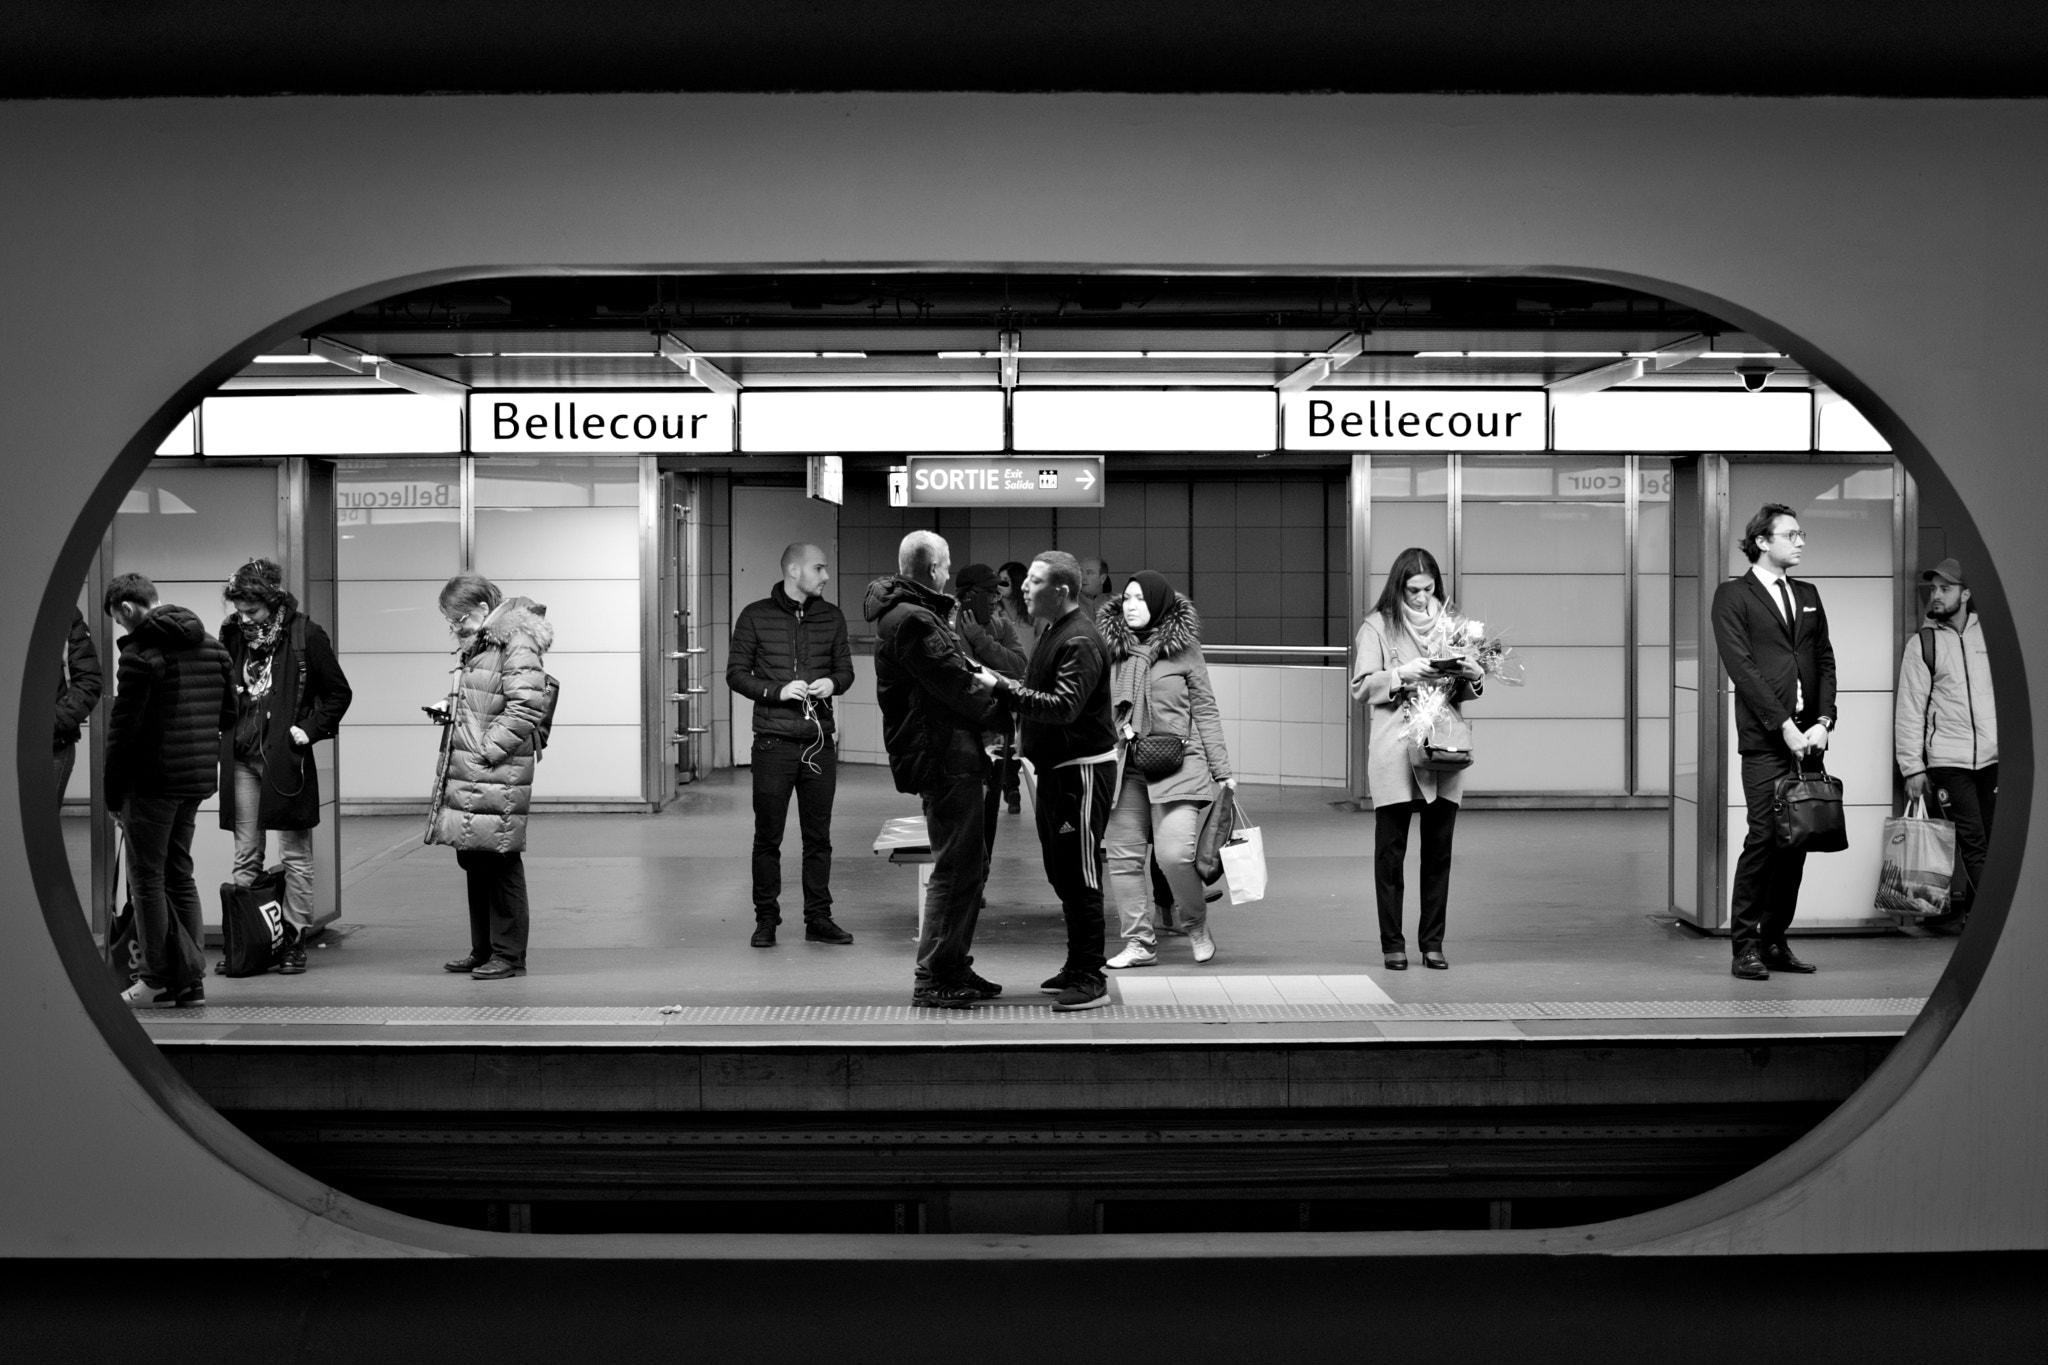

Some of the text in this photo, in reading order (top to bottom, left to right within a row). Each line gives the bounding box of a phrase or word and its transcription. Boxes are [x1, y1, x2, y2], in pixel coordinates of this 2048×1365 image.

[494, 402, 708, 440] Bellecour
[1309, 400, 1522, 437] Bellecour
[915, 468, 1000, 490] SORTIE
[1004, 468, 1024, 479] Exit
[1004, 479, 1035, 490] Salida
